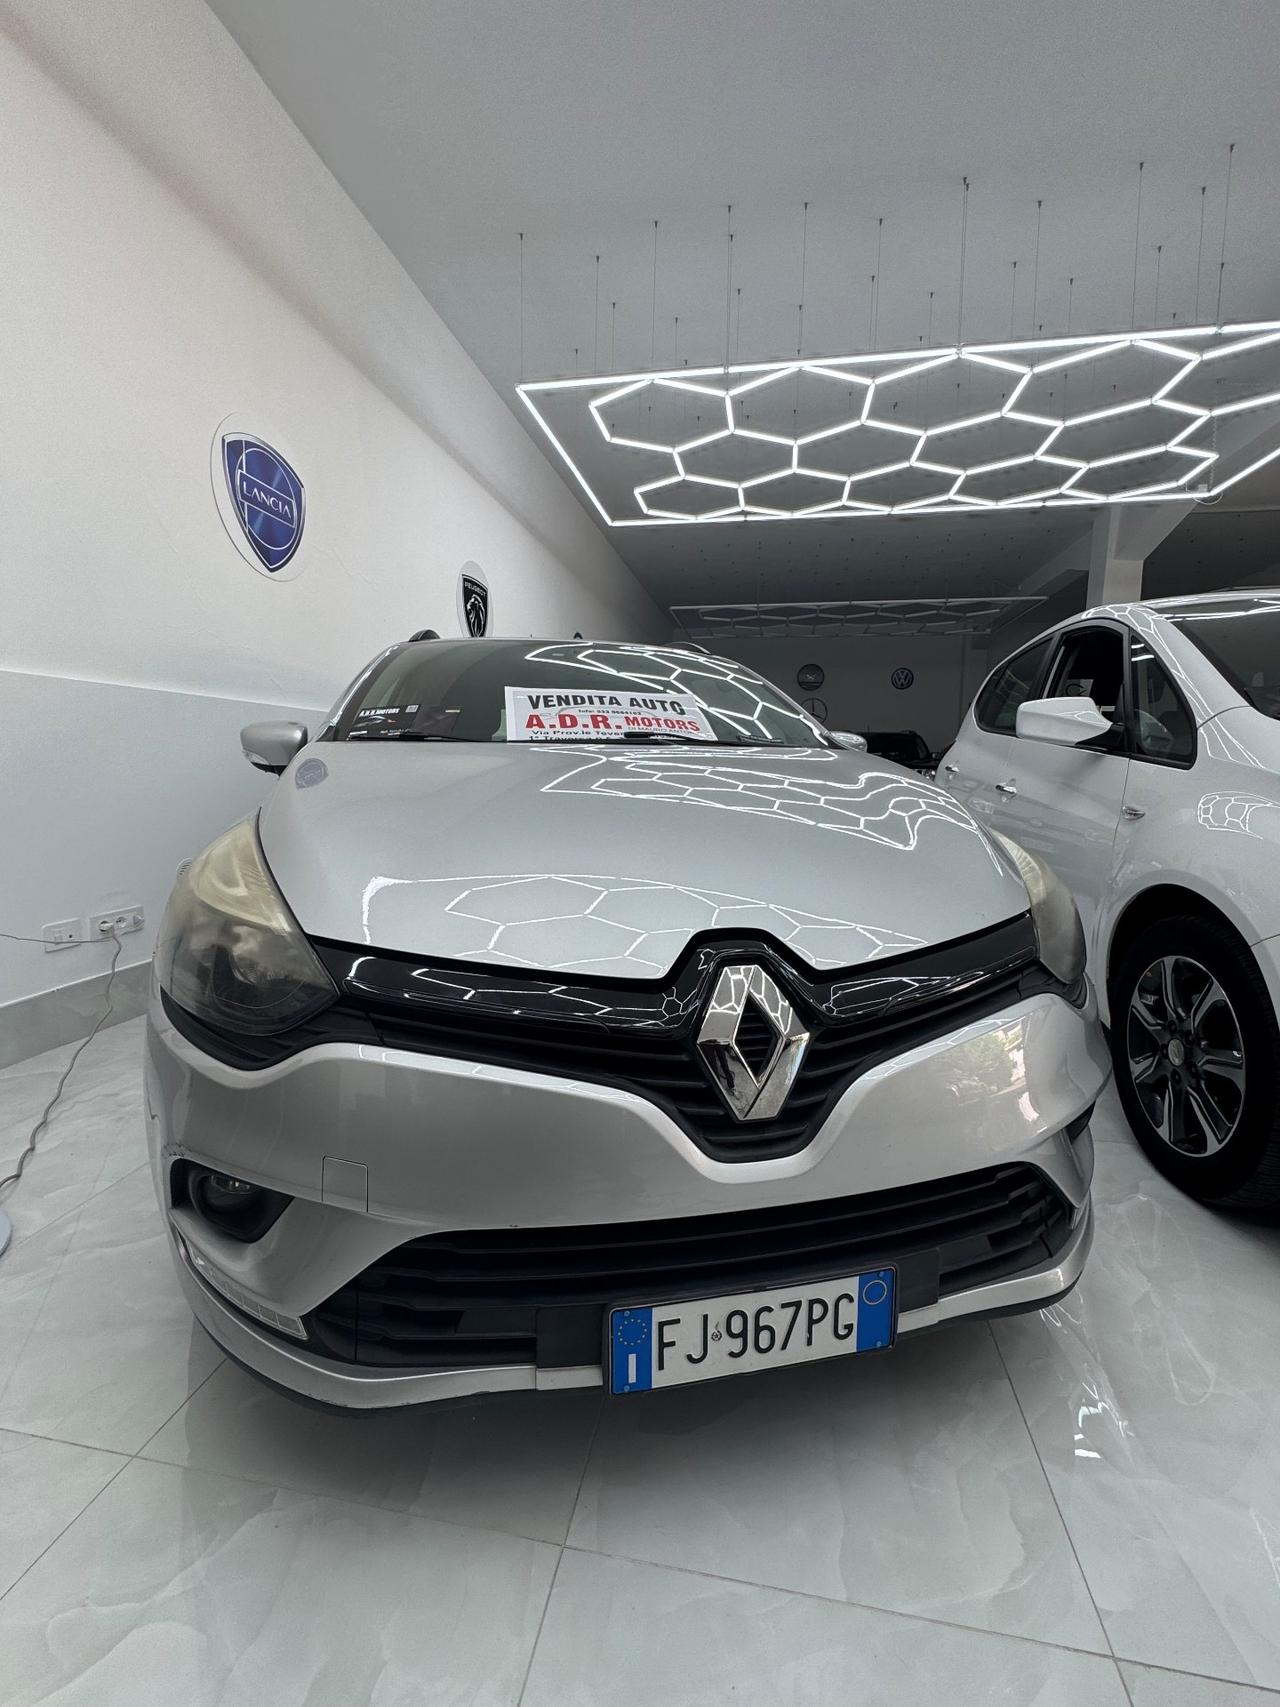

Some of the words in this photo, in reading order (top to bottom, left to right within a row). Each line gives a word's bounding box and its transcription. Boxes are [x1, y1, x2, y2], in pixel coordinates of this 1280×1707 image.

[243, 480, 291, 518] LANCIA
[528, 695, 622, 709] VENDITA
[629, 697, 687, 716] AUTO
[525, 714, 623, 730] A.D.R.
[624, 716, 701, 732] MOTORS
